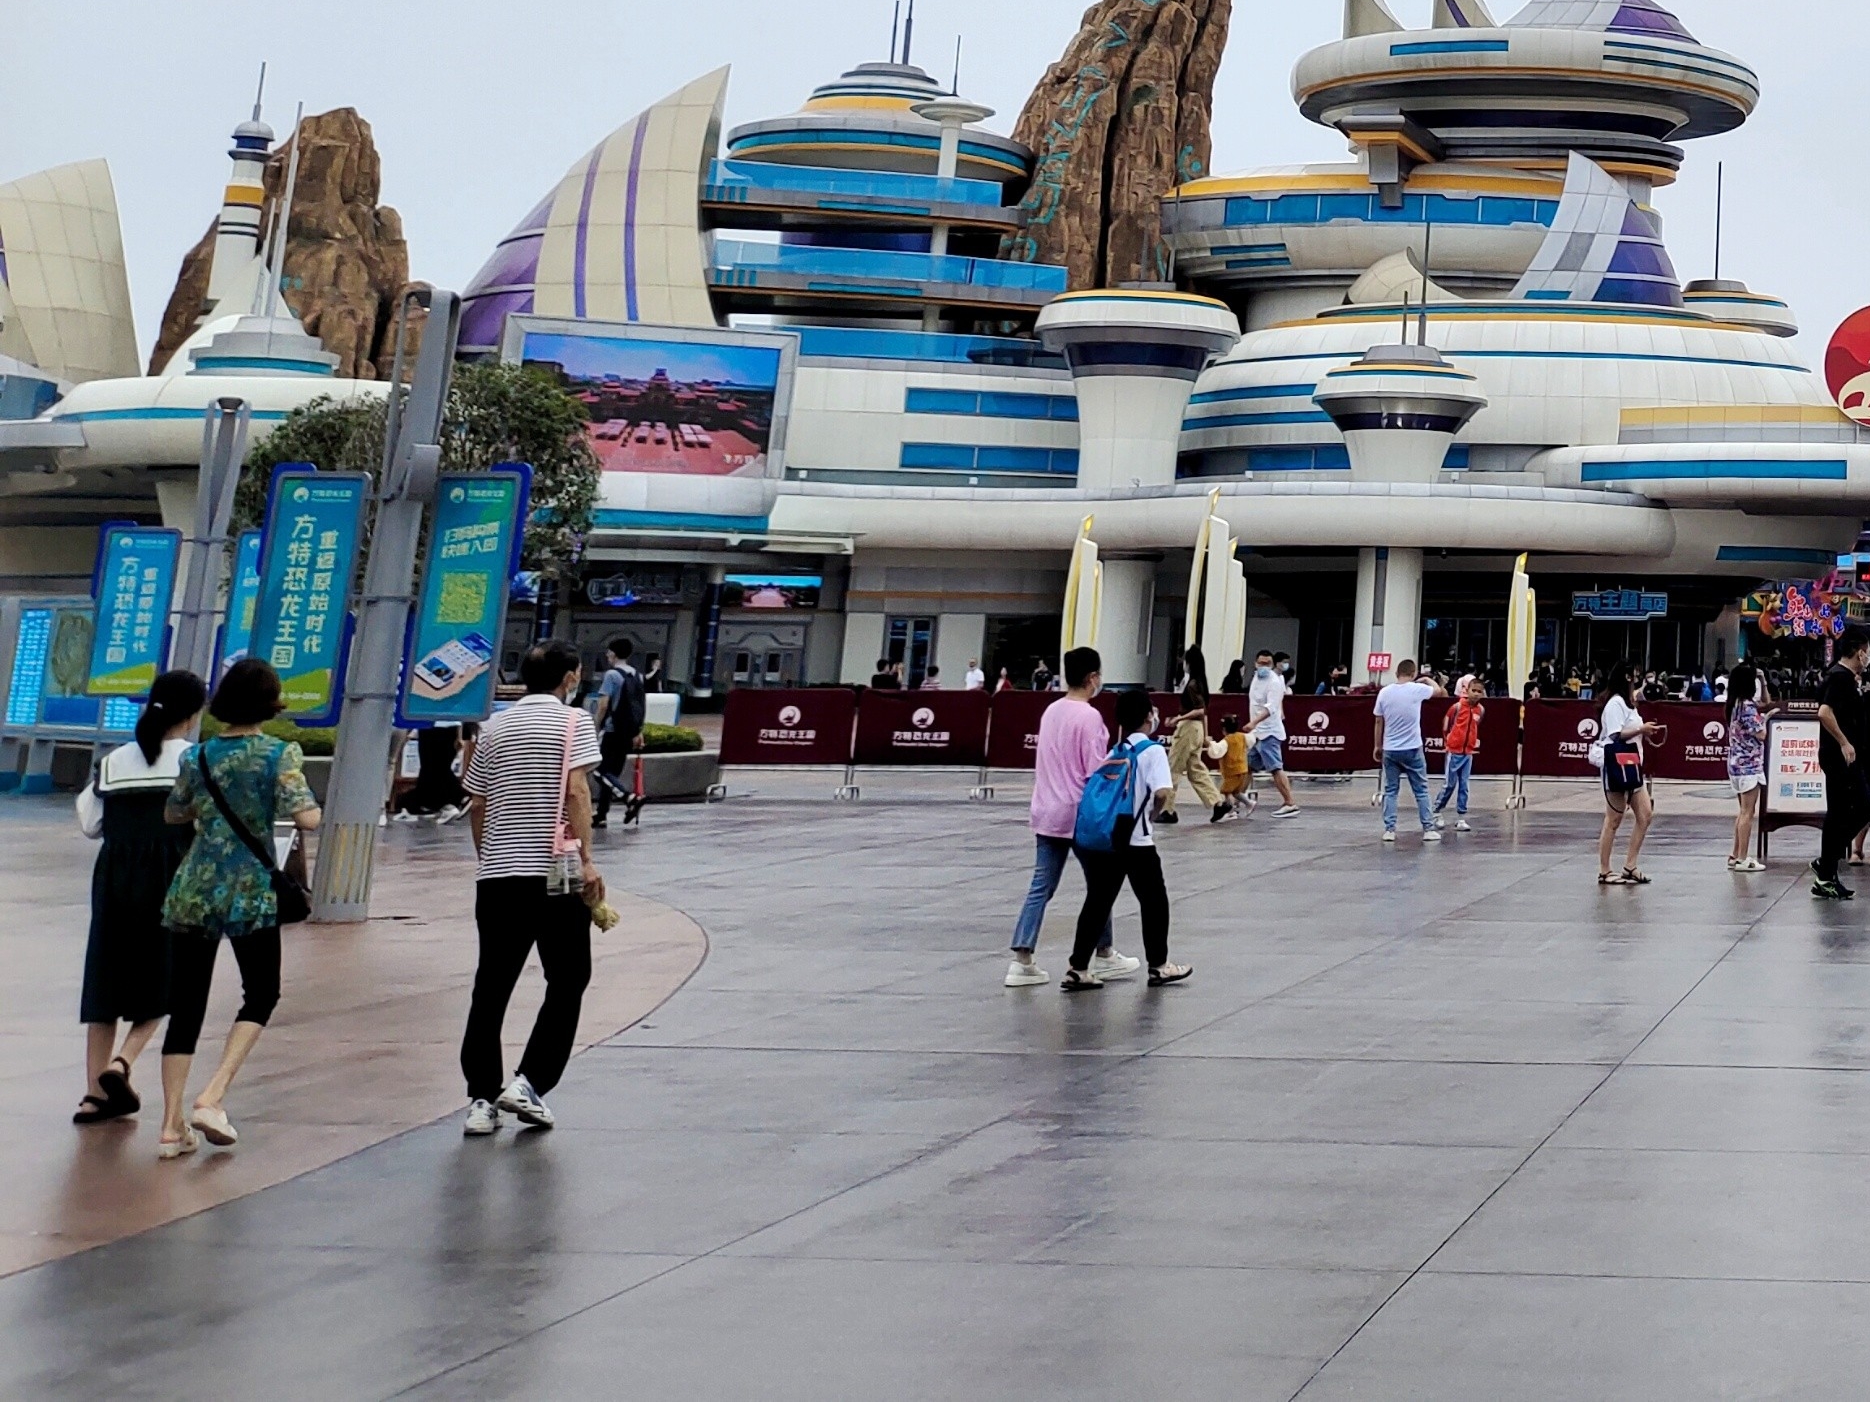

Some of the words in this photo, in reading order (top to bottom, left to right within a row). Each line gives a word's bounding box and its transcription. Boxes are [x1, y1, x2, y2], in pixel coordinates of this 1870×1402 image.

[270, 513, 318, 669] 方特恐龙王国
[302, 529, 339, 654] 重返原始时代
